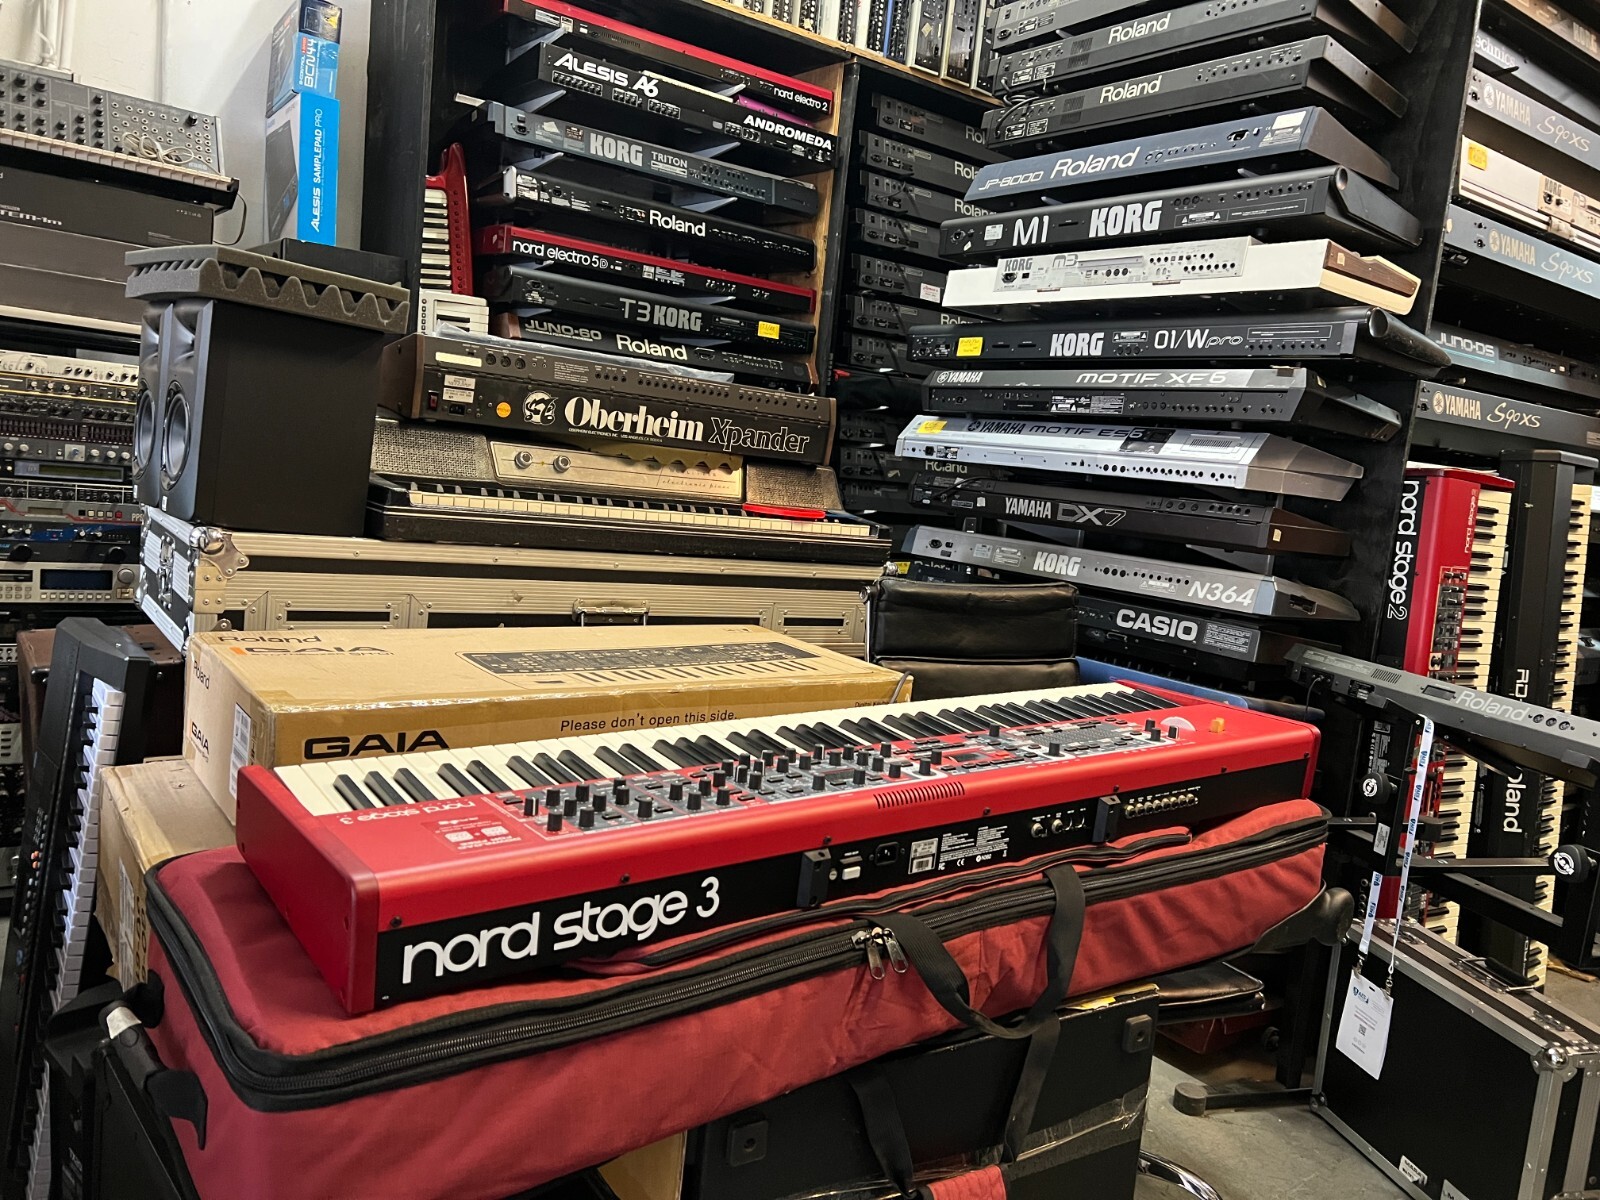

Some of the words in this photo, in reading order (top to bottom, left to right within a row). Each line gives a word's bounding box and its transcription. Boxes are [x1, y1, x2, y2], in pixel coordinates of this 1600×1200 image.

[1108, 13, 1170, 44] Roland
[1475, 36, 1516, 68] echnics
[553, 53, 629, 87] ALESIS
[632, 75, 659, 98] A6
[1100, 75, 1162, 104] Roland
[773, 88, 794, 101] nord
[794, 91, 821, 109] electro
[821, 102, 828, 111] 2
[1495, 89, 1531, 128] YAMAHA
[315, 108, 323, 128] PRO
[743, 115, 832, 151] ANDROMEDA
[590, 132, 643, 167] KORG
[651, 151, 688, 168] TRITON
[965, 125, 986, 145] Rol
[313, 128, 323, 184] SAMPLEPAD
[954, 161, 979, 180] Rol
[978, 170, 1044, 192] JP-8000
[1050, 146, 1142, 179] Roland
[311, 187, 321, 233] ALESIS
[650, 209, 706, 237] Roland
[954, 198, 997, 217] Rolan
[1012, 215, 1049, 246] M1
[1088, 200, 1163, 238] KORG
[512, 240, 544, 258] nord
[546, 247, 590, 267] electro
[1004, 257, 1034, 272] KORG
[1500, 233, 1536, 267] YAMAHA
[619, 297, 651, 322] T3
[653, 307, 703, 332] KORG
[616, 334, 688, 361] Roland
[1050, 332, 1104, 357] KORG
[947, 371, 983, 383] YAMAHA
[1076, 373, 1163, 384] MOTIF
[1165, 371, 1227, 384] XF6
[1444, 394, 1481, 420] YAMAHA
[564, 396, 704, 442] Oberheim
[708, 417, 810, 454] Xpander
[979, 421, 1026, 435] YAMAHA
[1029, 425, 1092, 436] MOTIF
[1005, 497, 1052, 519] YAMAHA
[1056, 502, 1127, 527] DX7
[1397, 480, 1420, 536] nord
[1033, 550, 1082, 577] KORG
[1187, 580, 1256, 607] N364
[1388, 541, 1414, 605] stage
[1116, 608, 1199, 642] CASIO
[1387, 604, 1408, 621] 2
[218, 635, 322, 644] Roland
[560, 718, 607, 733] Please
[610, 712, 645, 728] don't
[648, 713, 680, 728] open
[684, 710, 706, 724] this
[709, 708, 738, 722] side.
[1455, 690, 1531, 722] Roland
[191, 721, 210, 755] GAIA
[304, 730, 449, 760] GAIA
[402, 911, 540, 986] nord
[552, 890, 688, 951] stage
[696, 876, 720, 918] 3
